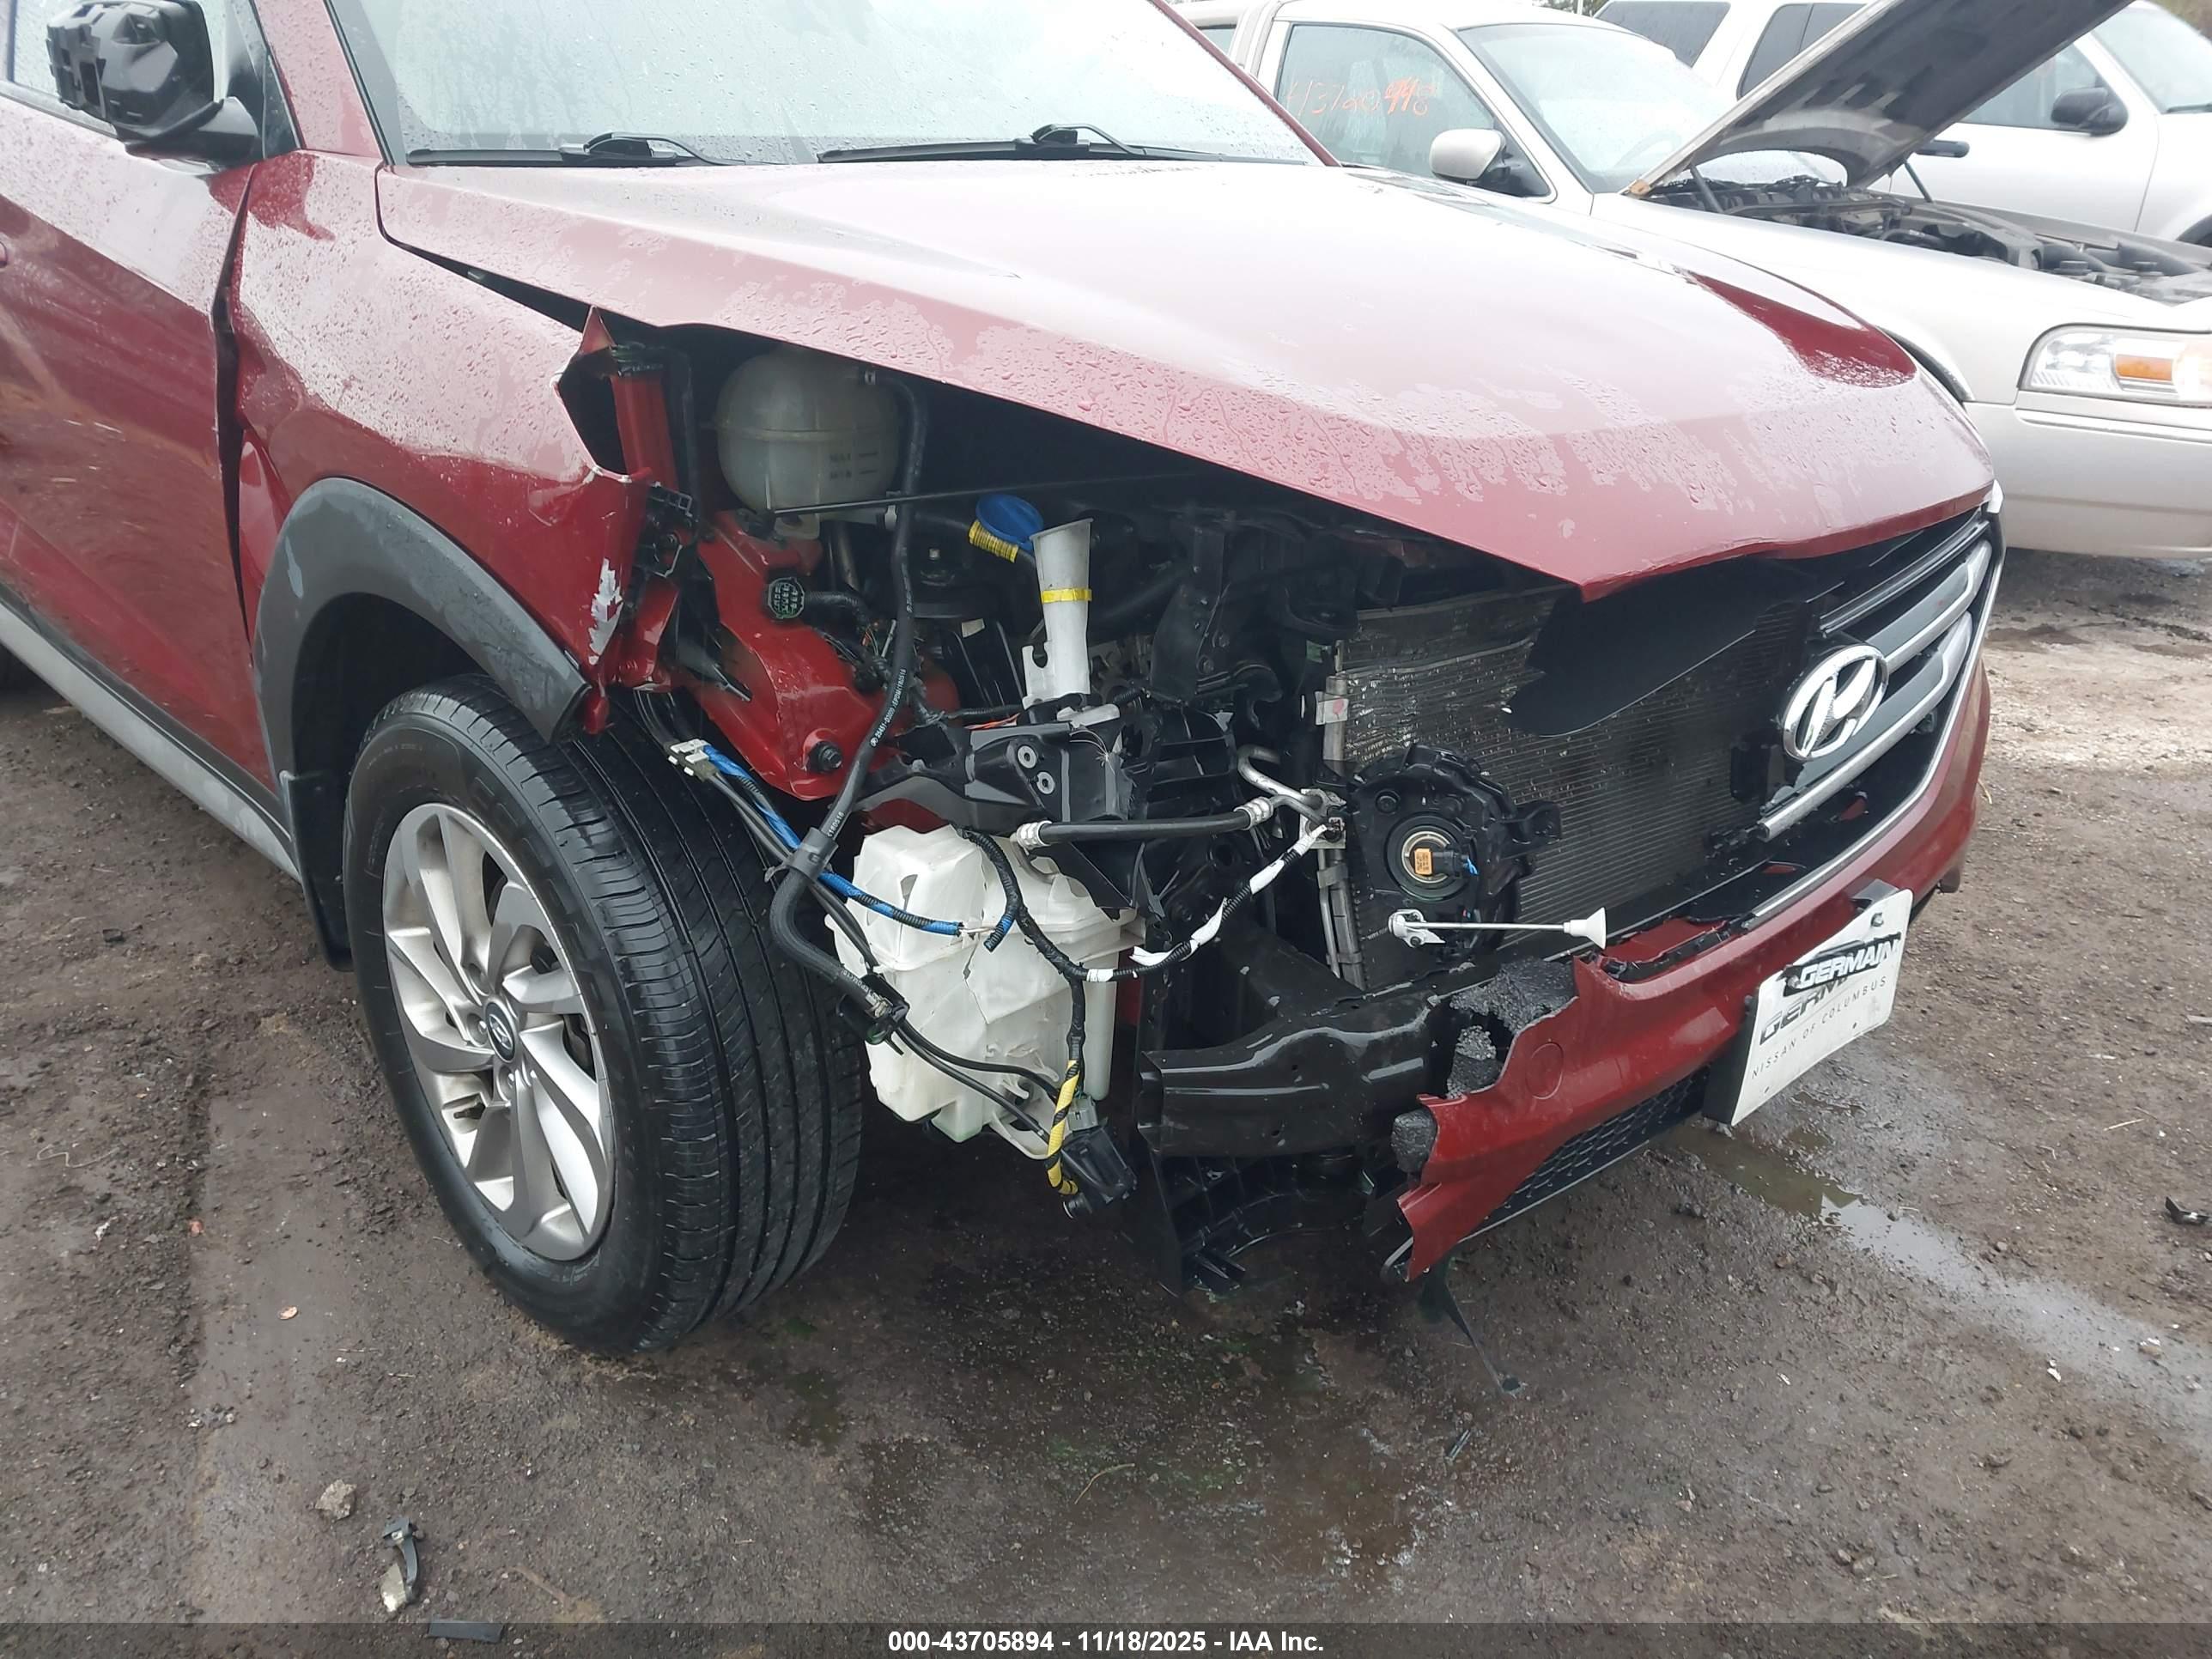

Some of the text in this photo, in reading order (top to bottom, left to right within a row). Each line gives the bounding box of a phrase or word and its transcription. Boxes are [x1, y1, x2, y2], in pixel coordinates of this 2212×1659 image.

[1798, 939, 1900, 989] GERMAIN
[1752, 975, 1887, 1079] NISSAN OF COLUMBUS
